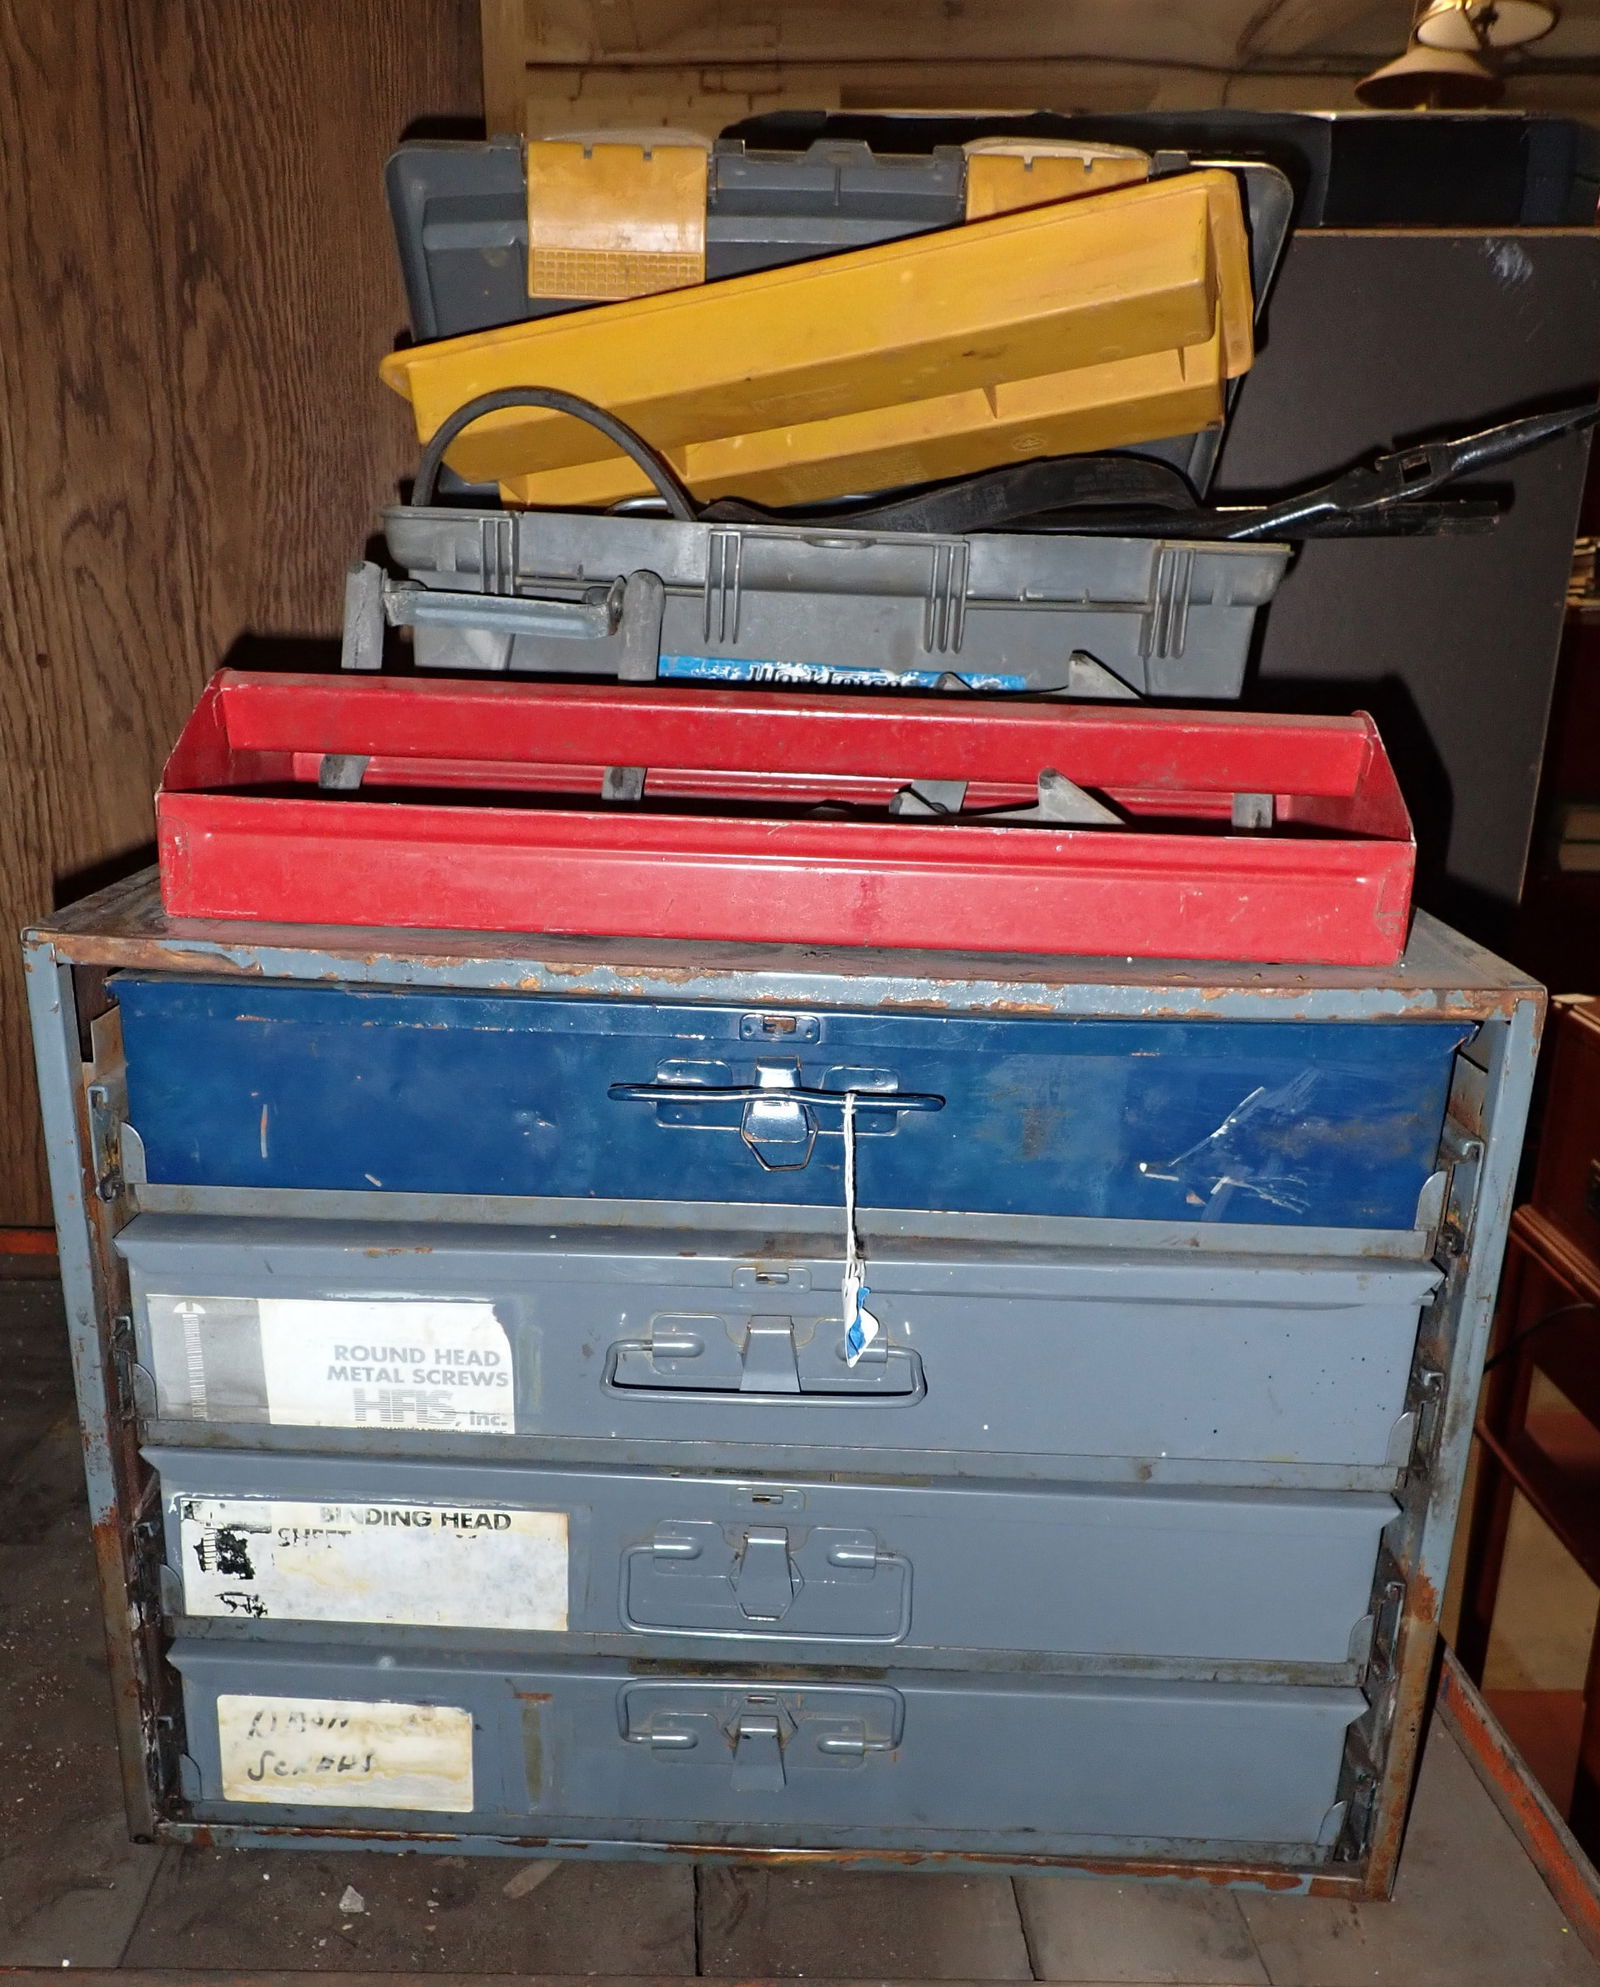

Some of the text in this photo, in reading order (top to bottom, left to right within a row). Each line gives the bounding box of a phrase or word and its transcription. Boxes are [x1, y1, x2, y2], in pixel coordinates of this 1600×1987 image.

[334, 1344, 500, 1367] ROUND HEAD
[327, 1365, 509, 1387] METAL SCREWS
[319, 1505, 512, 1531] BINDING HEAD
